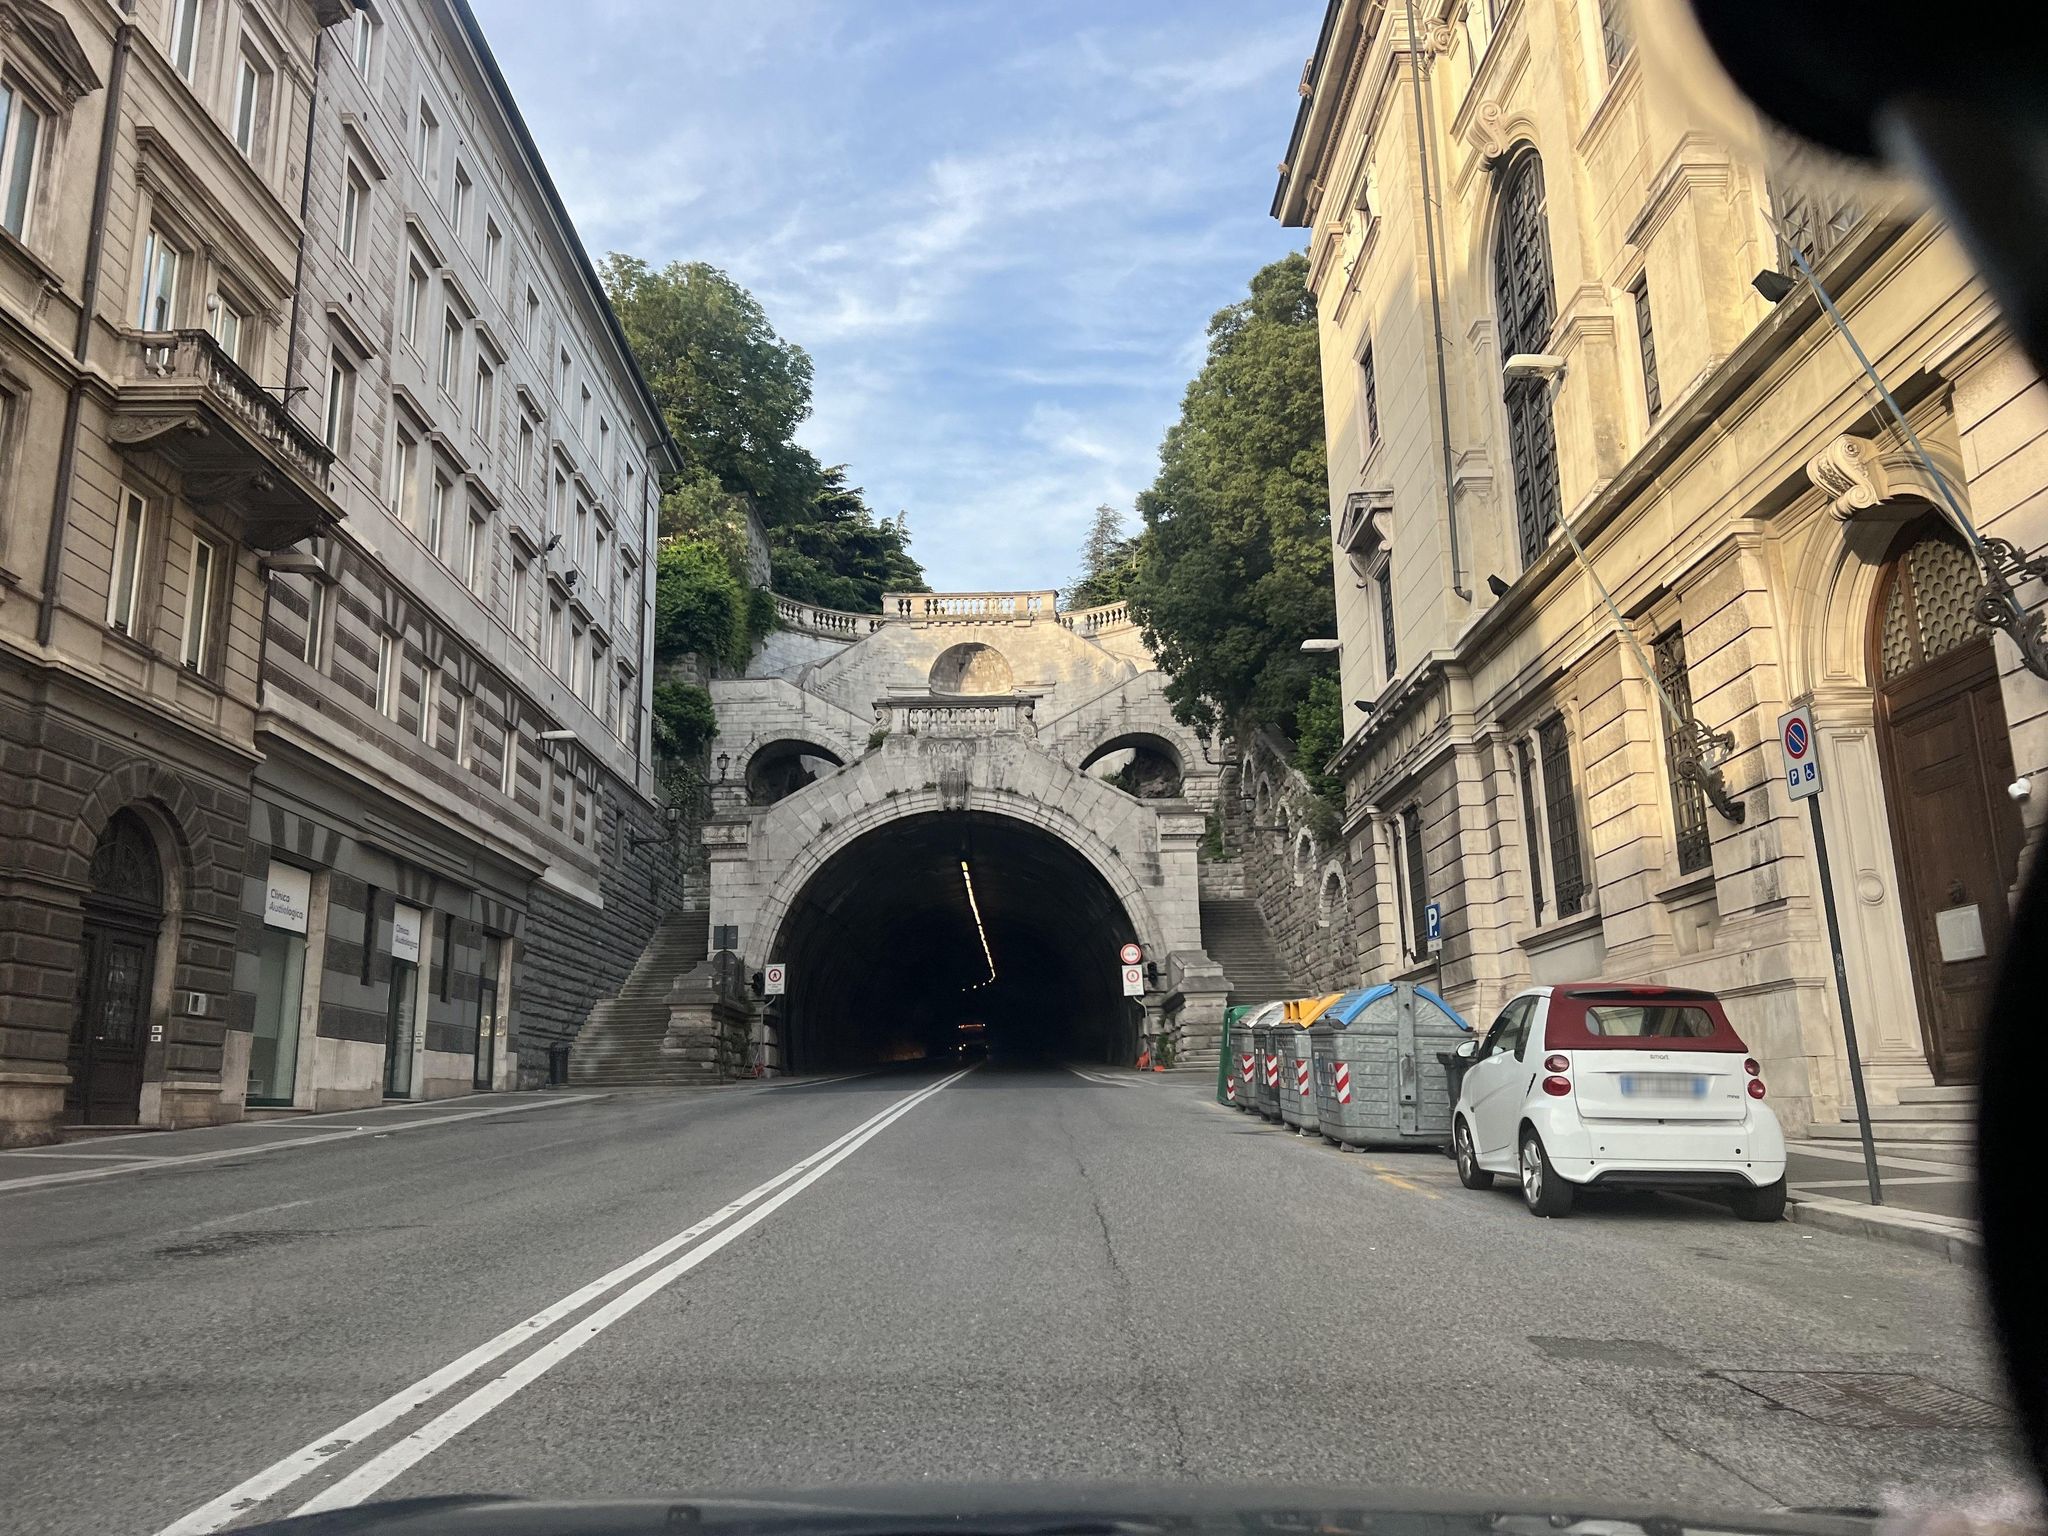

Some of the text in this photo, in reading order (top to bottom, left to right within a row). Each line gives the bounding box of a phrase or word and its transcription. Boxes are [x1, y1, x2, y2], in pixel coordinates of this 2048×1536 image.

[1790, 770, 1798, 784] P
[270, 888, 291, 903] Clinica
[268, 901, 304, 921] Audiologica
